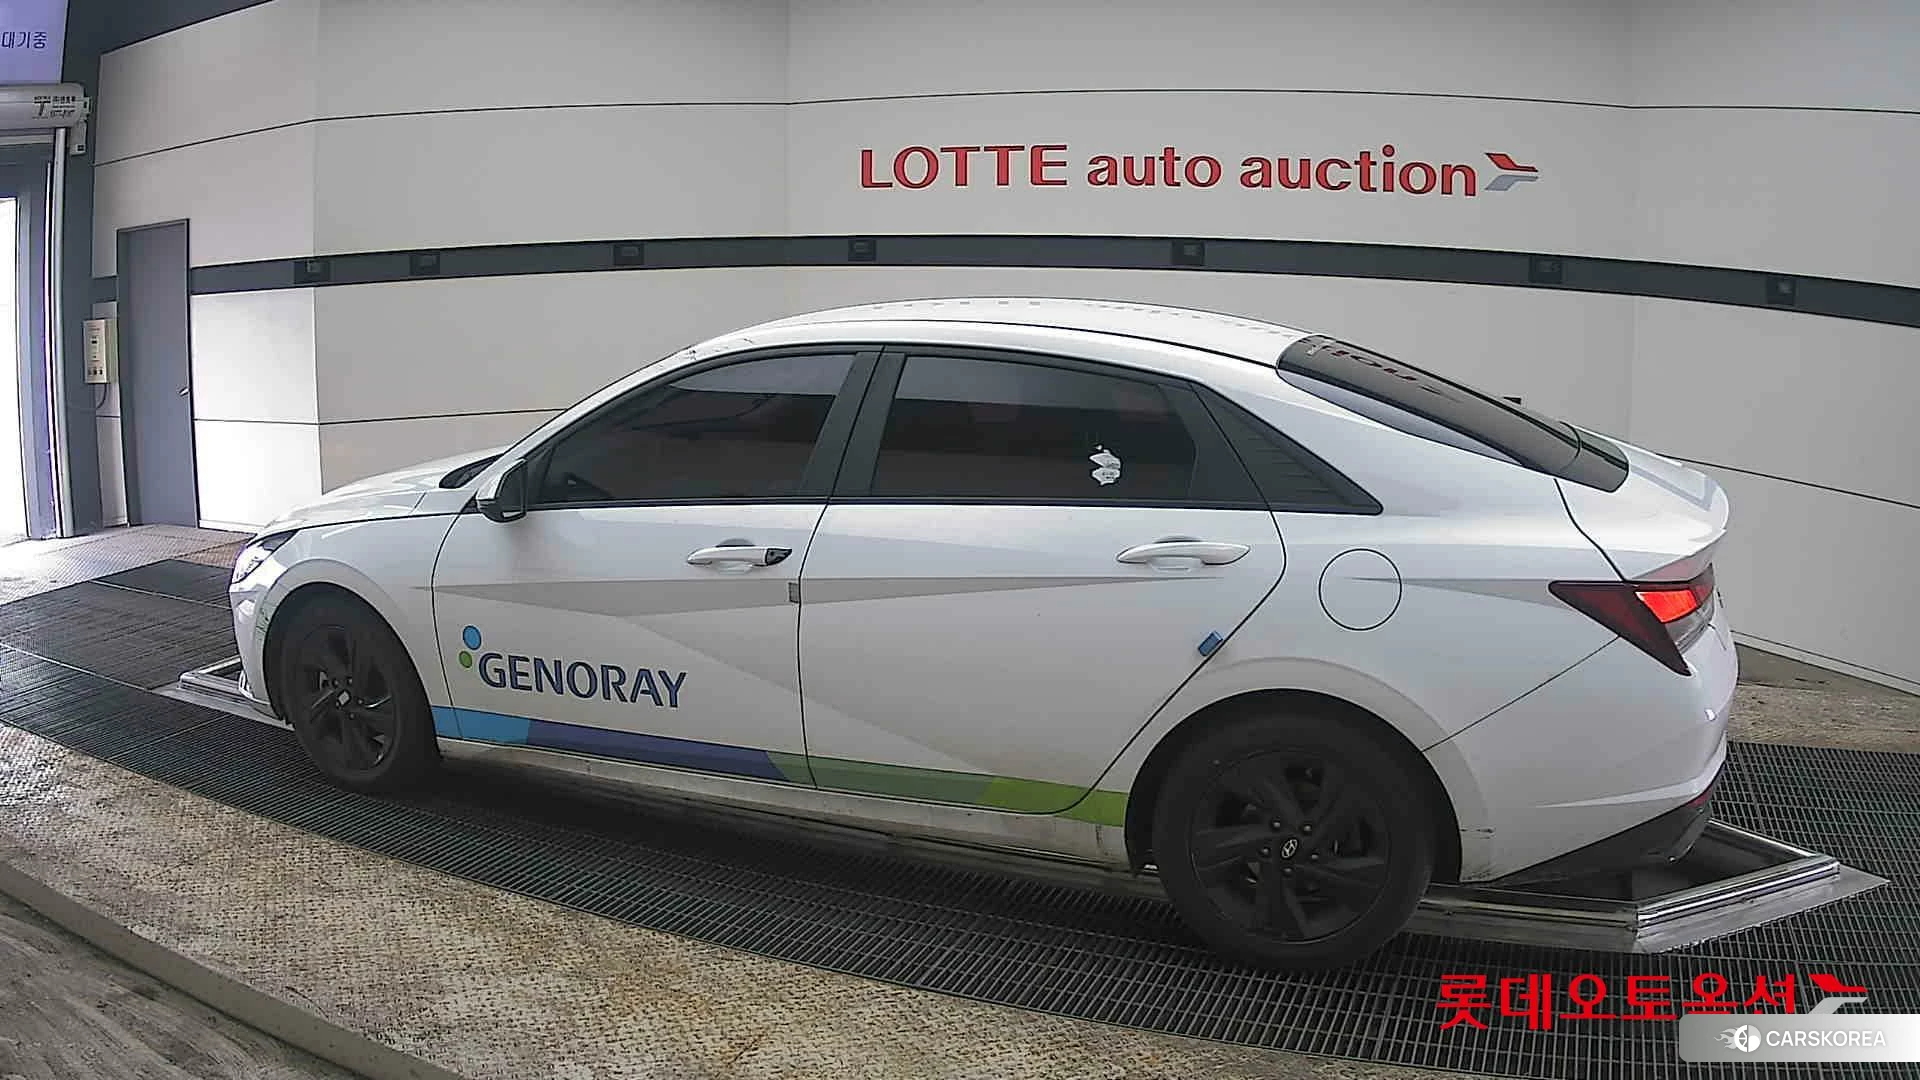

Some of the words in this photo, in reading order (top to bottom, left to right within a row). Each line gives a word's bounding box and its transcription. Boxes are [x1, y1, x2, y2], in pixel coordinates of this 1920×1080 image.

[1, 31, 47, 49] 대기중
[860, 144, 1068, 189] LOTTE
[1087, 146, 1223, 188] auto
[1240, 144, 1478, 197] auction
[478, 651, 688, 709] GENORAY
